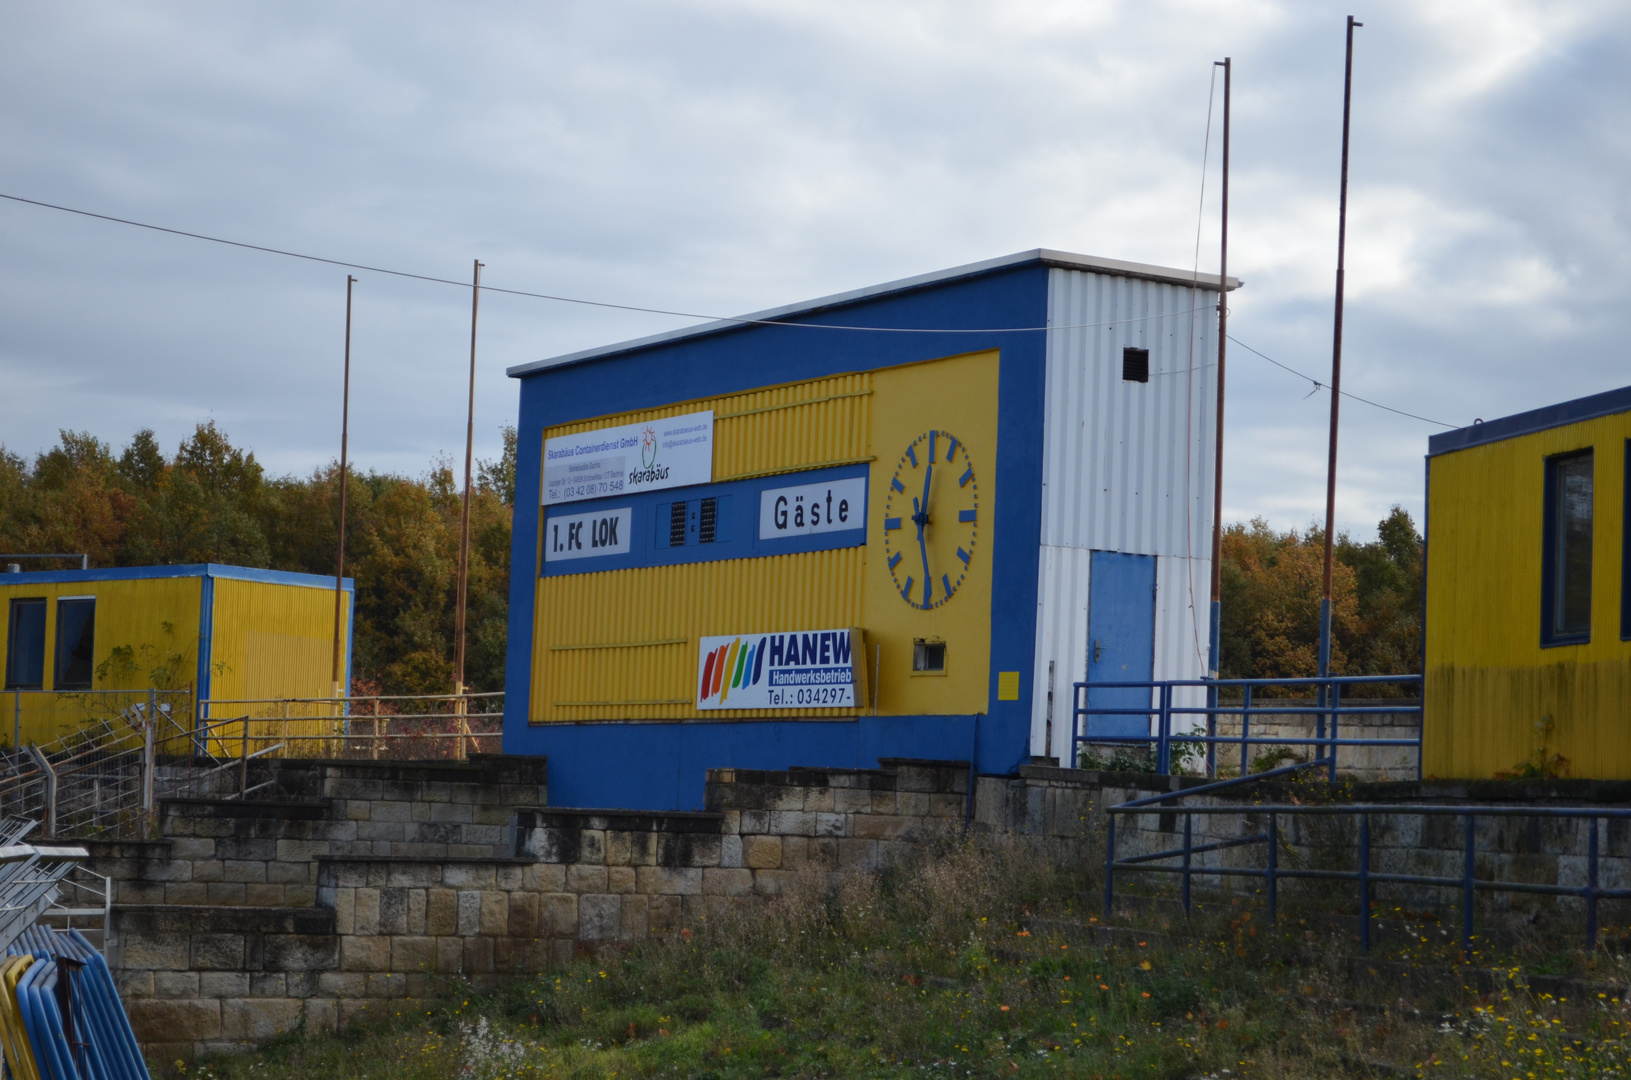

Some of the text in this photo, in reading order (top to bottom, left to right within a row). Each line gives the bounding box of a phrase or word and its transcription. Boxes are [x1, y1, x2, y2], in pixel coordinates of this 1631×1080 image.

[547, 436, 639, 460] Skarabäus Containerdienst GmbH
[629, 464, 670, 485] skarabäus
[548, 480, 624, 500] Tel.: (03 42 08) 70 548
[774, 489, 849, 530] Gäste
[553, 516, 619, 552] 1. FC LOK
[769, 631, 851, 667] HANEW
[772, 668, 852, 685] Handwerksbetrieb
[768, 688, 851, 705] Tel.: 034297-
